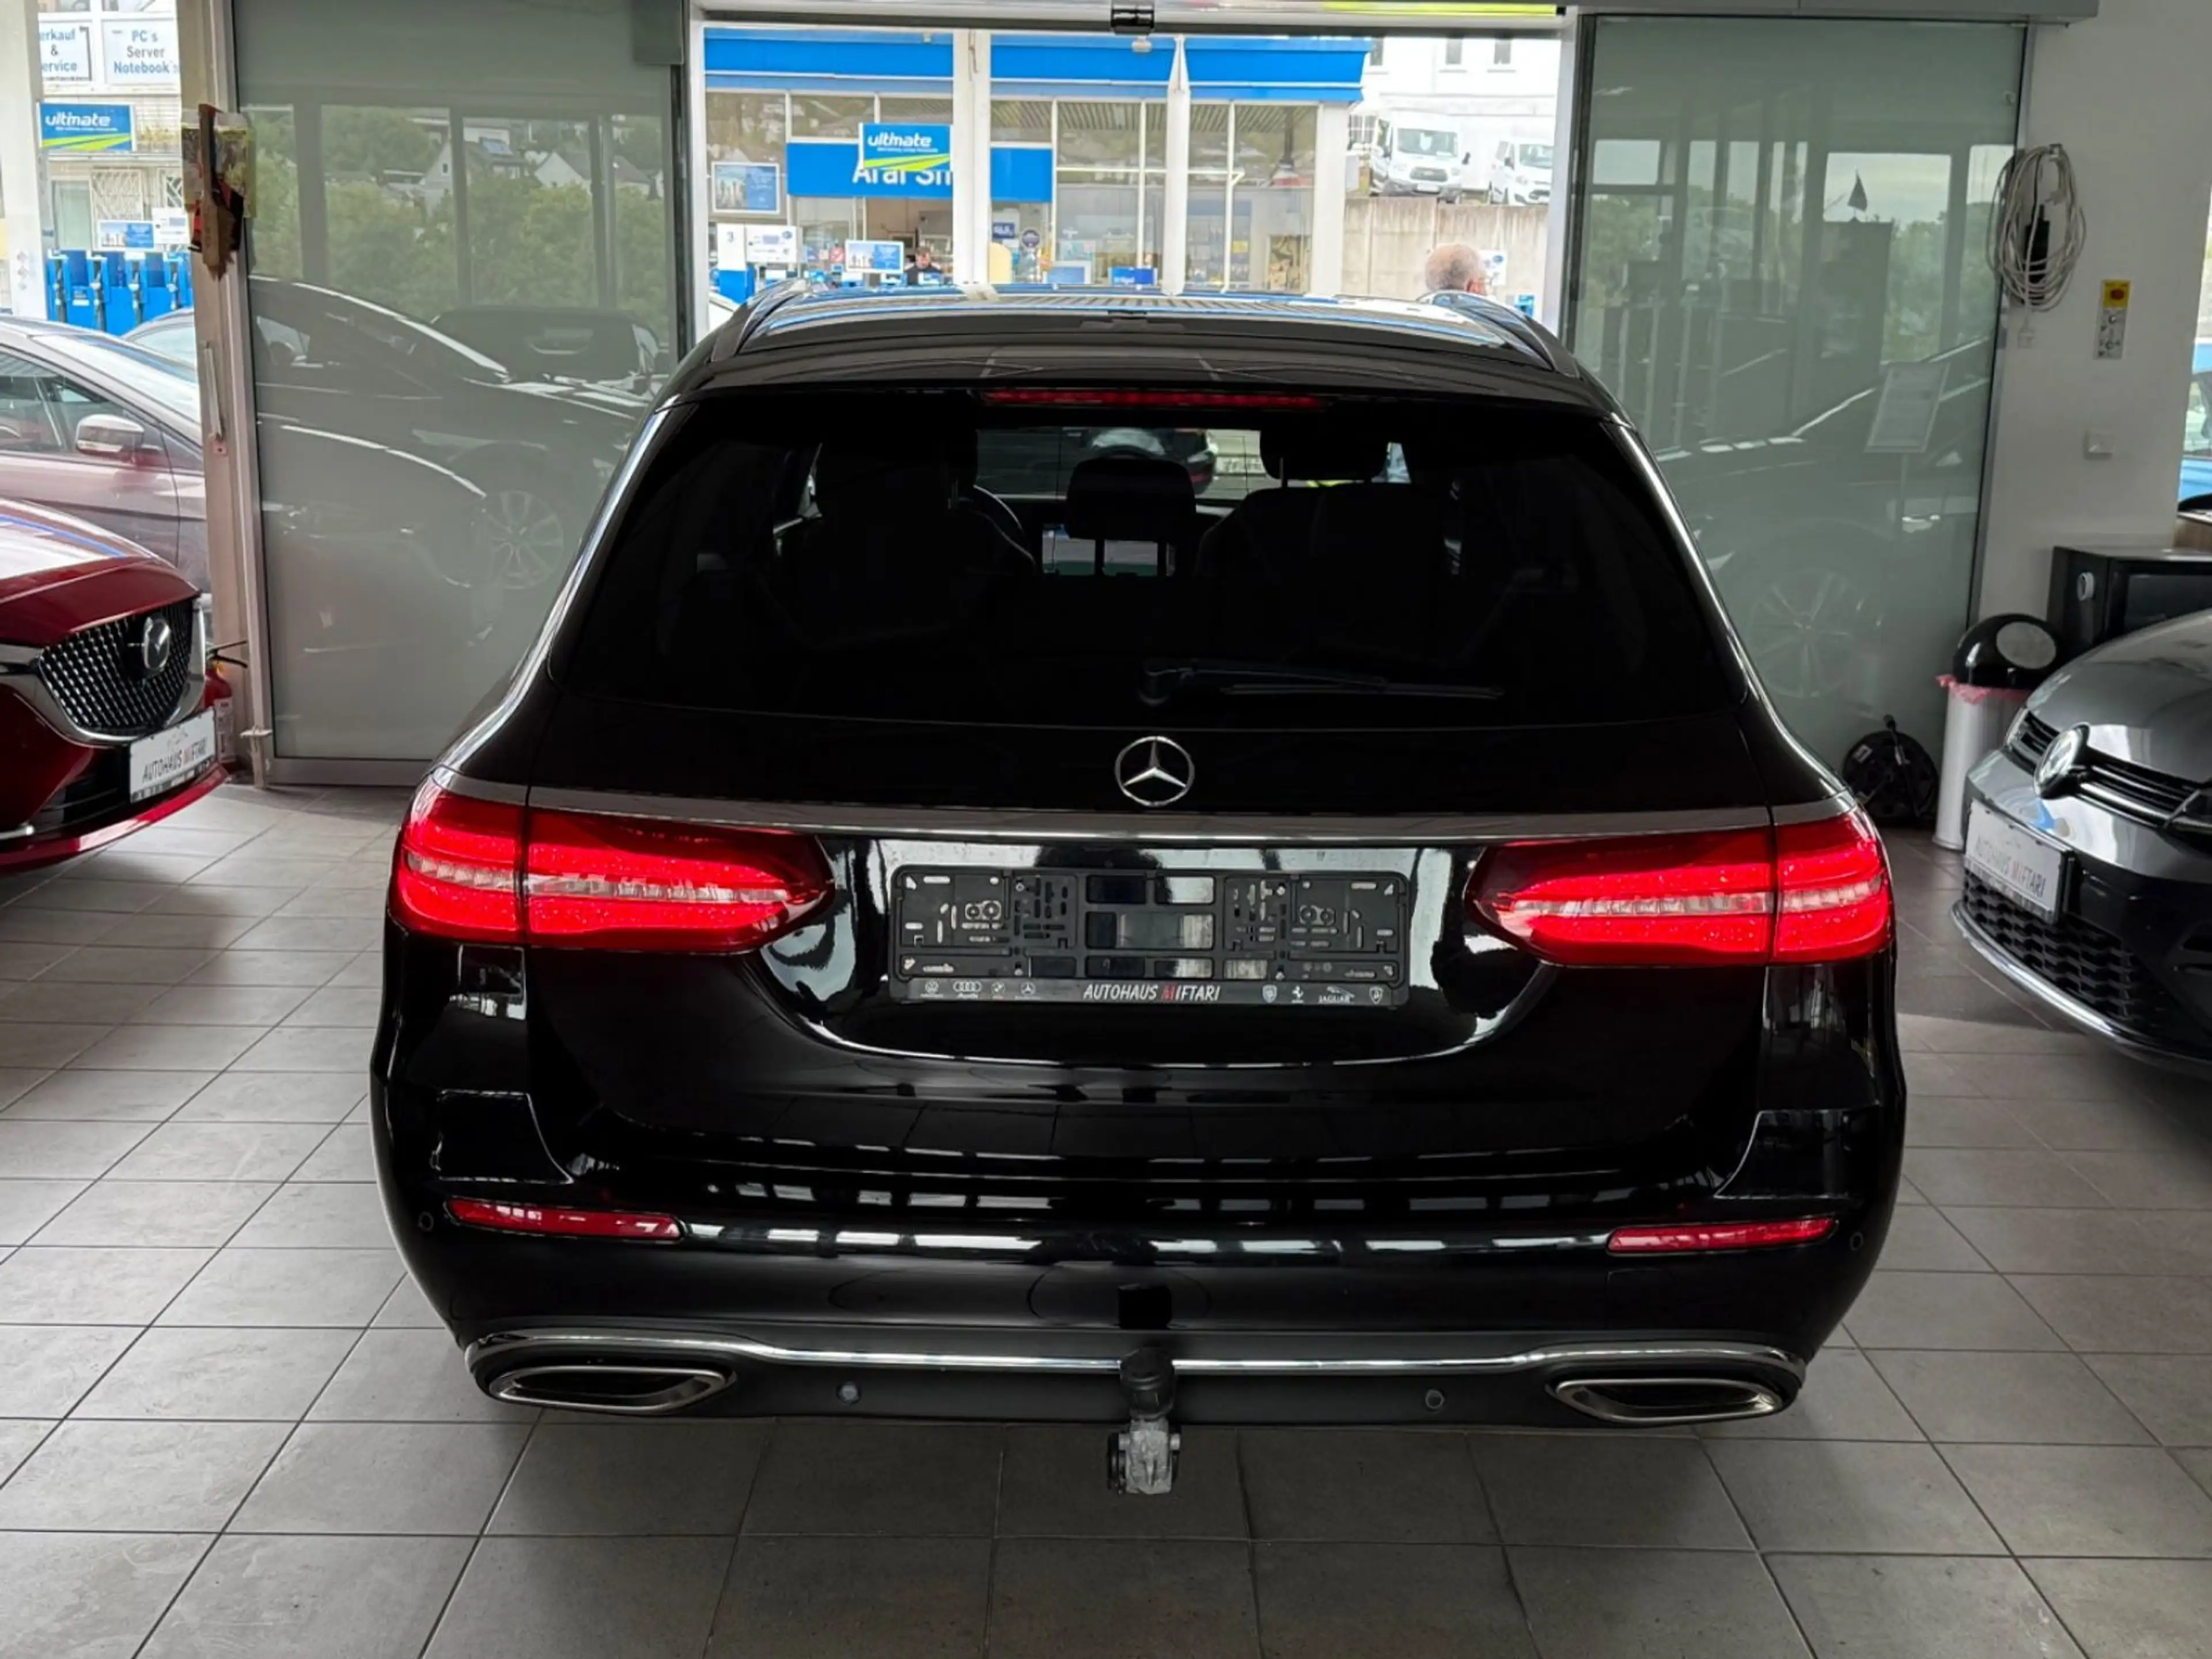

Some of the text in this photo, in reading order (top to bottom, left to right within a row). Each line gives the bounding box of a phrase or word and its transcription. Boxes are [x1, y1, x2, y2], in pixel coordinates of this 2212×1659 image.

[127, 44, 165, 58] Server
[44, 110, 112, 127] ultimate
[867, 131, 932, 147] ultimate
[1083, 983, 1221, 1001] AUTOHAUS MIFTARI
